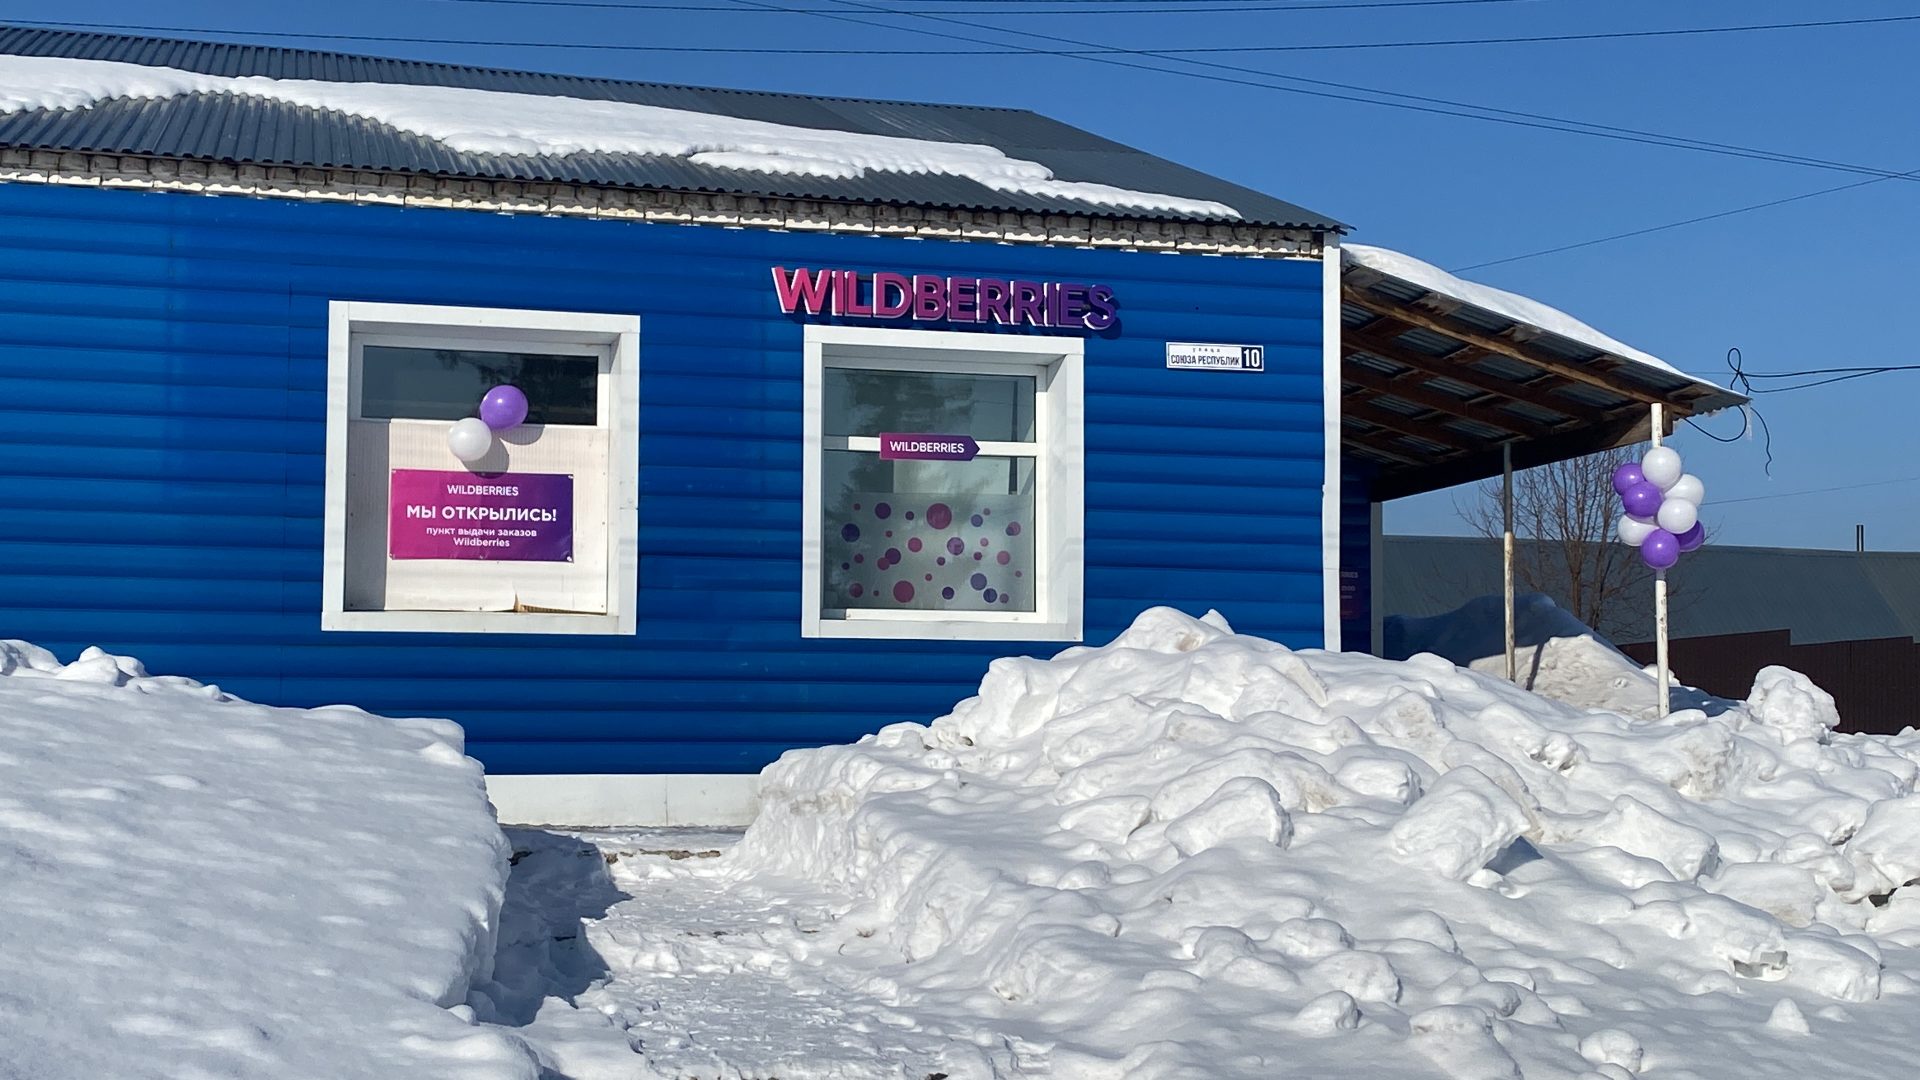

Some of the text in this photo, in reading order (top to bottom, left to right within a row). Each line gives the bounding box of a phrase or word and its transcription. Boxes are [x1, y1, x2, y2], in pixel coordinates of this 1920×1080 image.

[771, 267, 1116, 329] WILDBERRIES
[1171, 349, 1260, 367] СОЮЗА РЕСПУБЛИК 10
[889, 441, 964, 453] WILDBERRIES
[447, 485, 519, 496] WILDBERRIES
[407, 505, 557, 521] МЫ ОТКРЫЛИСЬ!
[426, 527, 455, 536] пункт
[458, 529, 495, 537] выдачи
[453, 537, 510, 547] Wildberries
